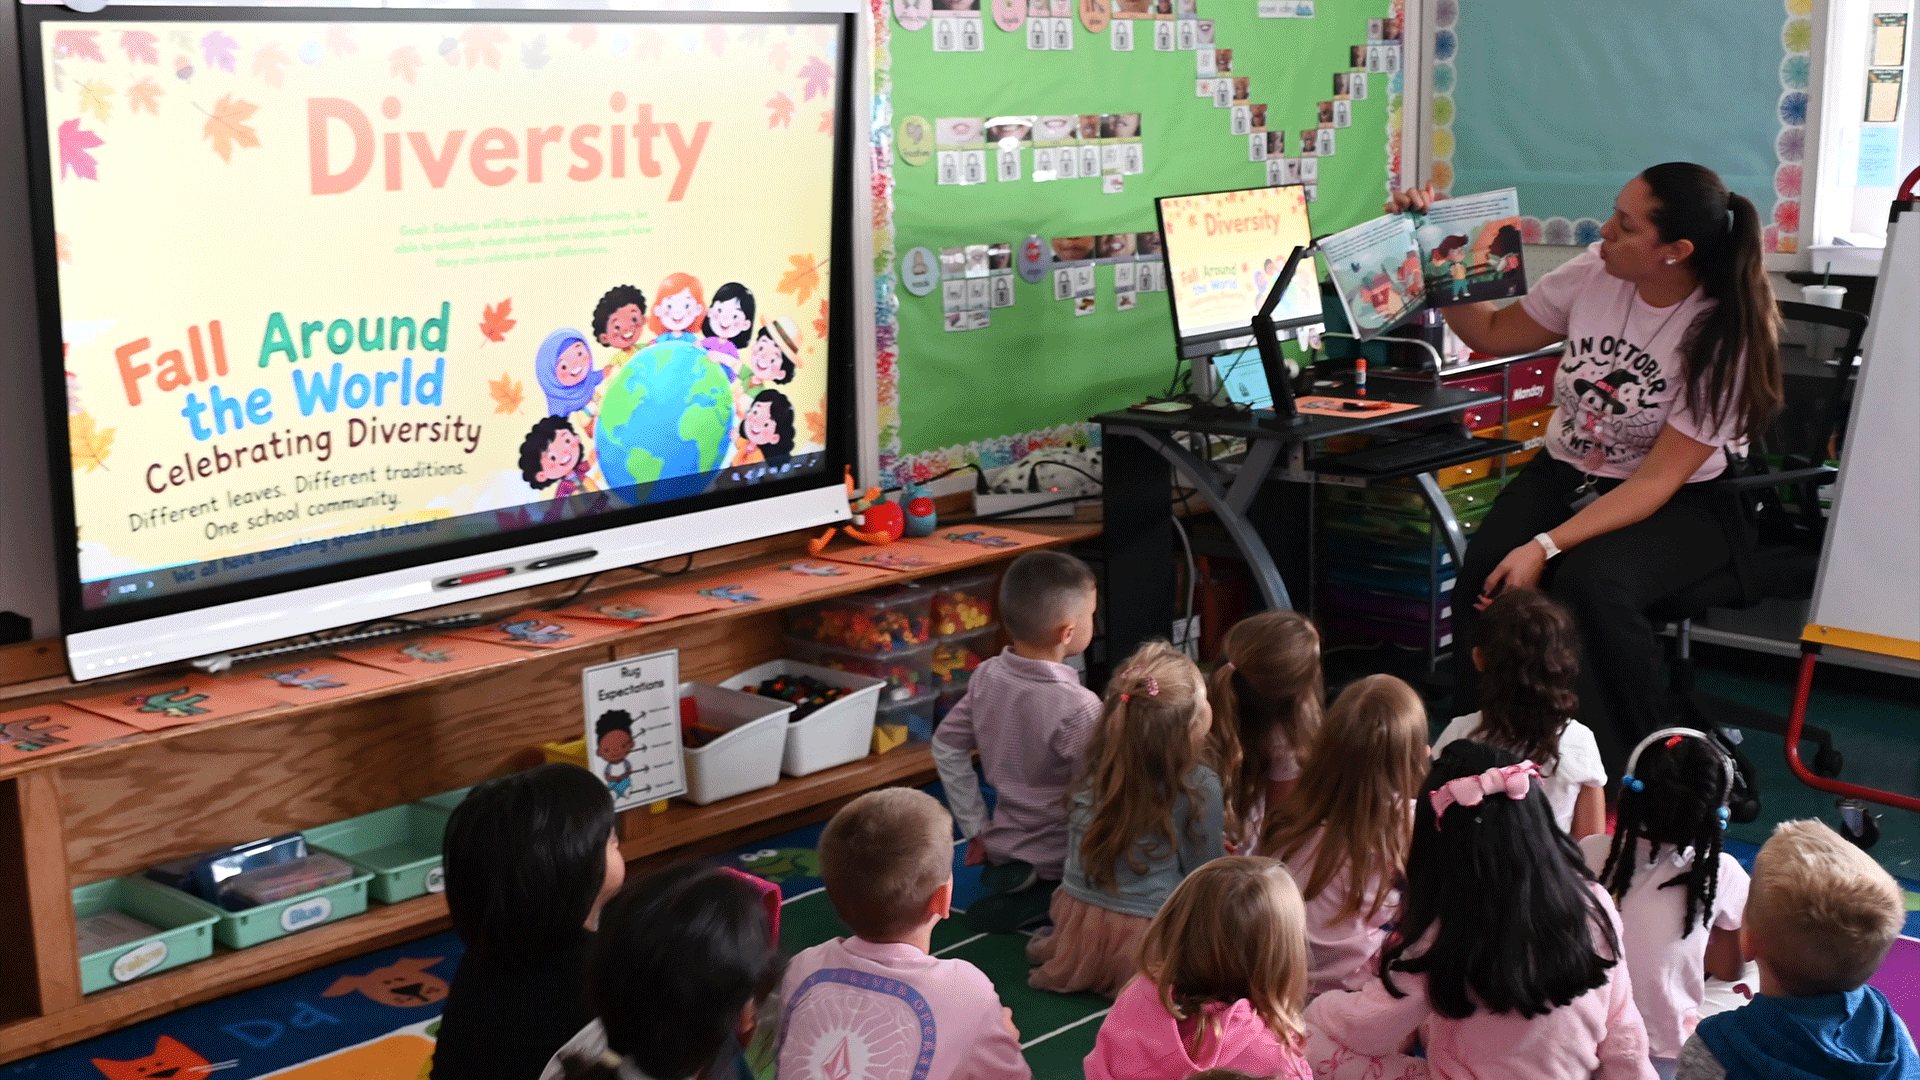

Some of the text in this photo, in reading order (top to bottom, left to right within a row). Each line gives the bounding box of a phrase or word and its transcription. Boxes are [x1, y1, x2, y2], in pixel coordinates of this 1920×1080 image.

[307, 89, 713, 203] Diversity
[394, 242, 418, 254] able
[422, 242, 433, 252] to
[436, 237, 475, 251] identify
[480, 235, 506, 247] what
[509, 234, 542, 245] makes
[544, 231, 570, 242] them
[611, 225, 631, 237] and
[632, 224, 653, 236] how
[399, 223, 429, 236] Goal:
[433, 221, 479, 234] Students
[481, 217, 502, 230] will
[503, 216, 517, 229] be
[518, 215, 541, 228] able
[544, 216, 555, 226] to
[557, 212, 587, 225] define
[637, 209, 649, 220] be
[1204, 209, 1280, 236] Diversity
[435, 257, 459, 269] they
[462, 256, 480, 266] can
[484, 250, 531, 264] celebrate
[534, 250, 552, 260] our
[114, 301, 451, 407] Fall Around
[1570, 335, 1667, 395] IN OCTOBER
[181, 356, 446, 441] the World
[1512, 384, 1545, 401] Monday
[145, 415, 482, 494] Celebrating Diversity
[128, 459, 468, 533] Different leaves. Different traditions.
[204, 490, 402, 540] One school community.
[172, 566, 197, 584] We
[202, 558, 218, 579] all
[222, 552, 255, 572] have
[259, 536, 329, 564] something
[332, 527, 380, 552] special
[598, 680, 664, 701] Expectations
[621, 666, 641, 679] Rug
